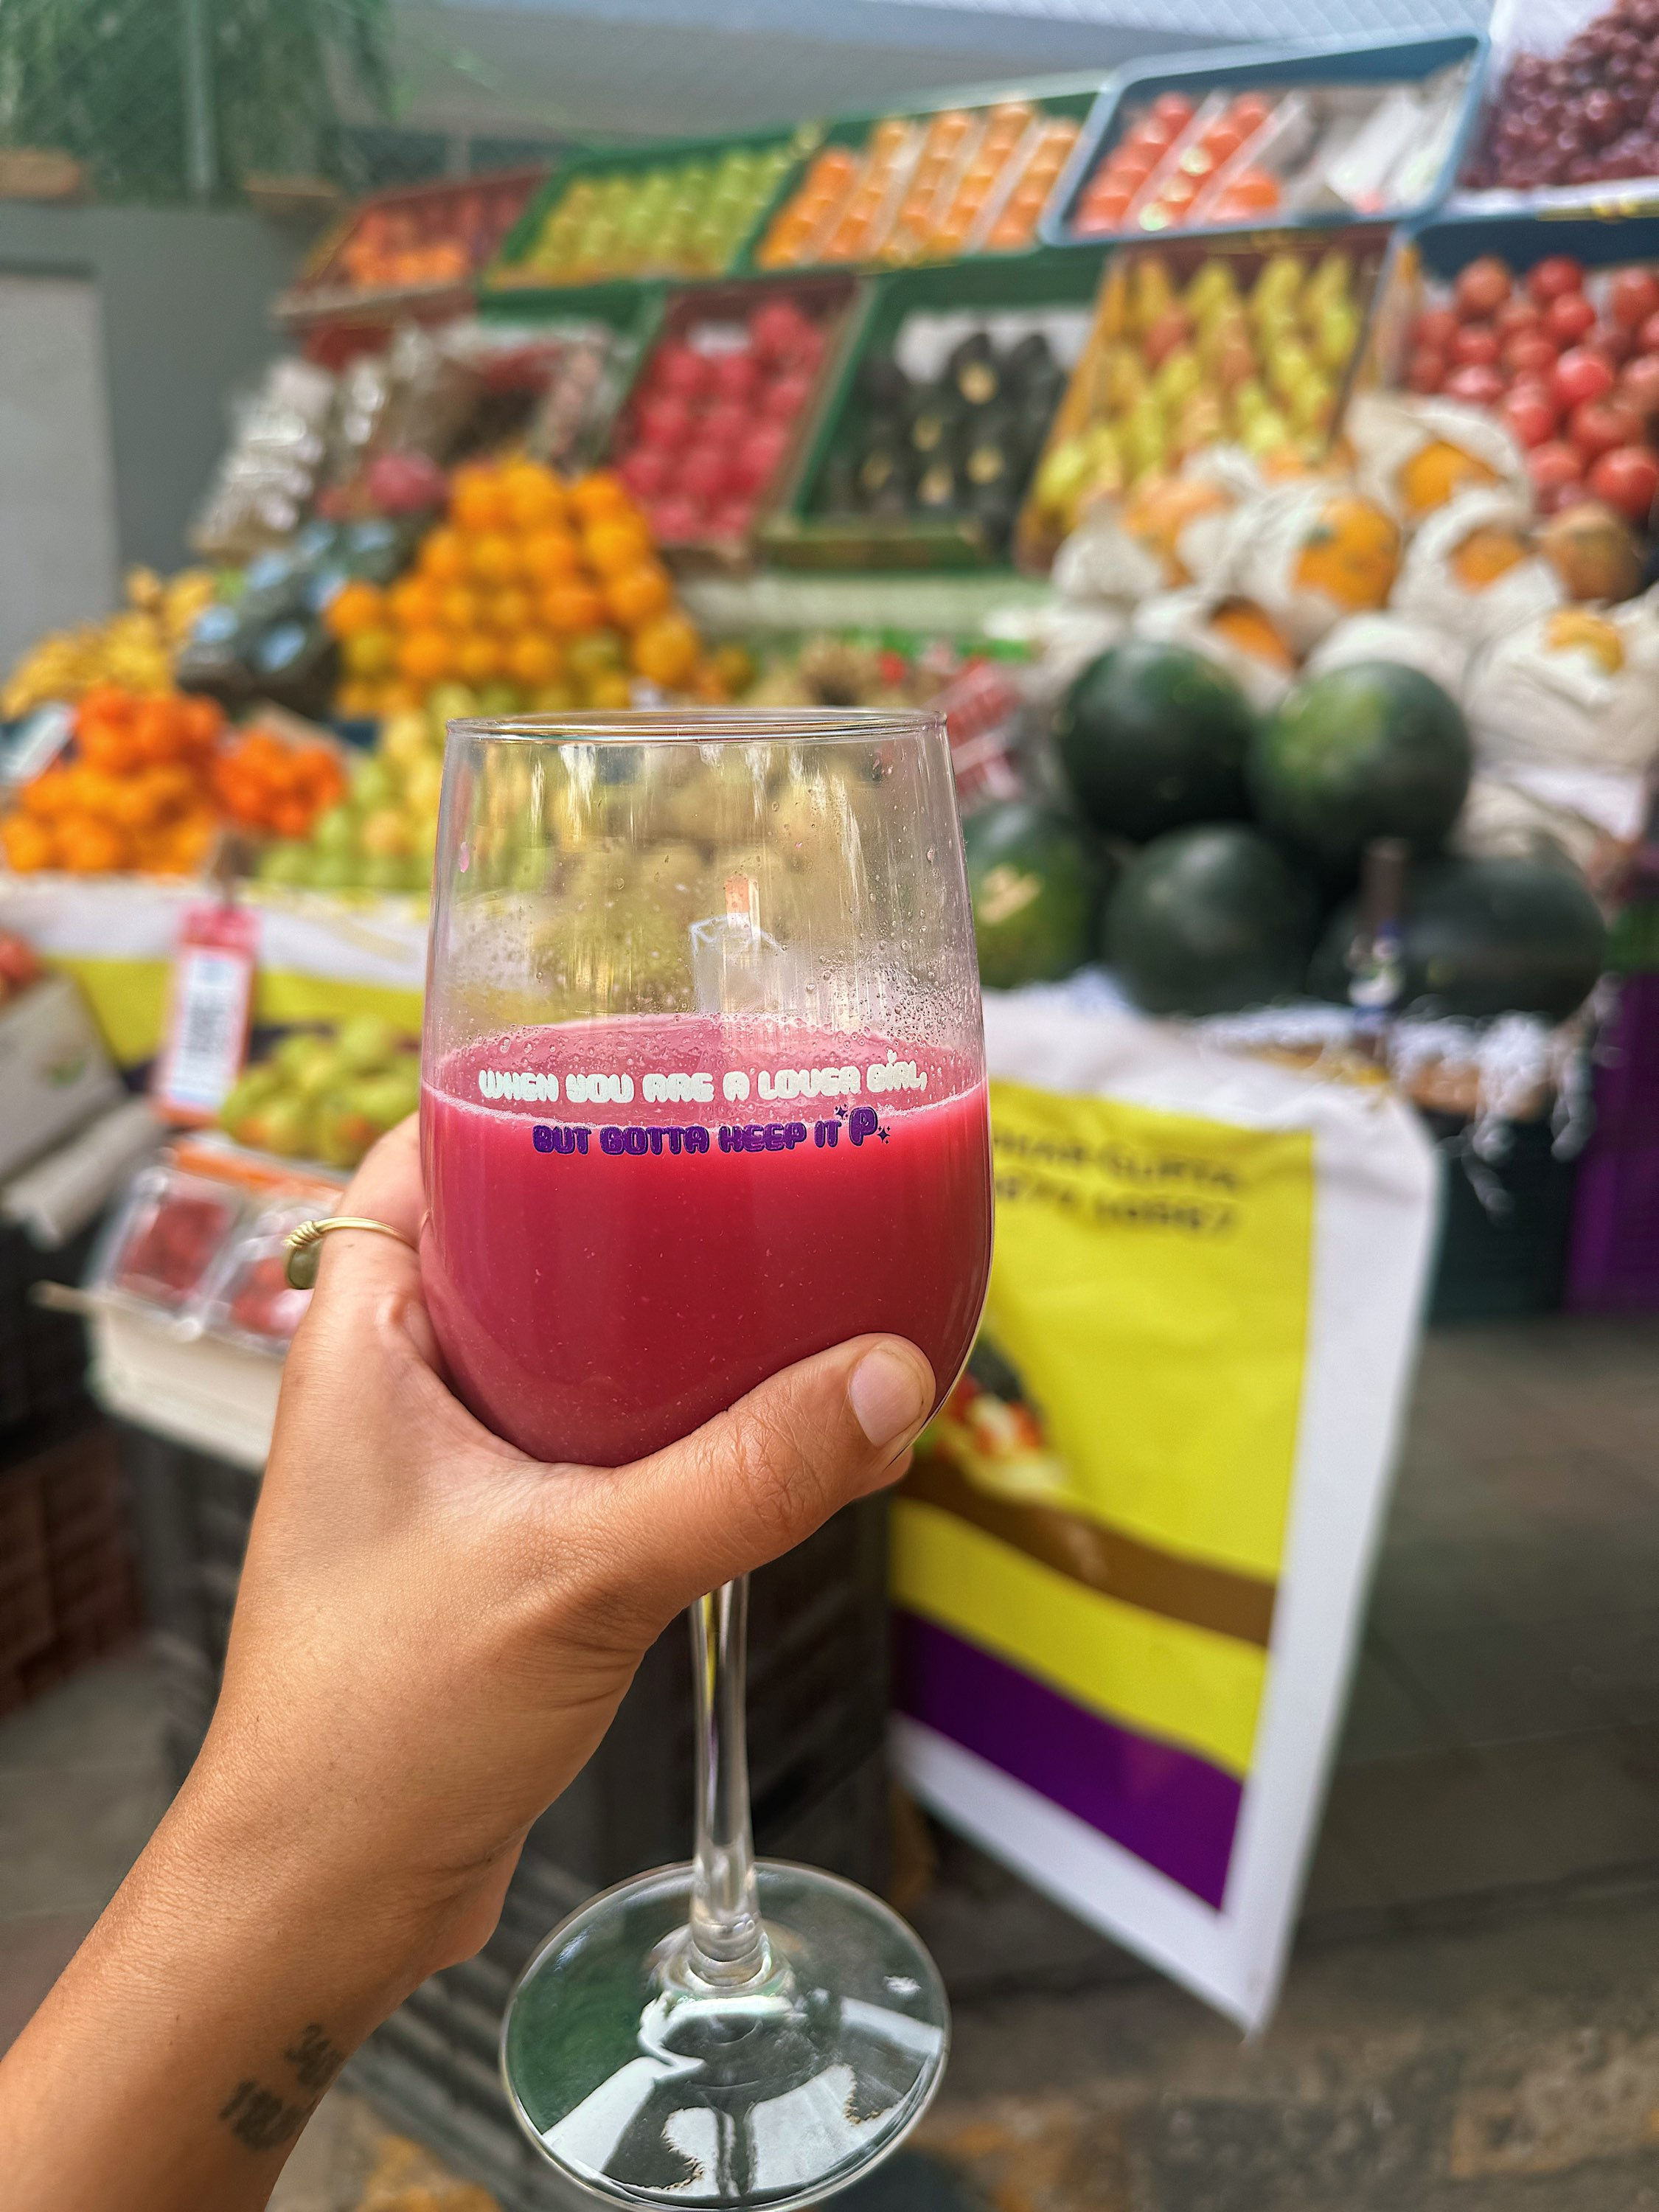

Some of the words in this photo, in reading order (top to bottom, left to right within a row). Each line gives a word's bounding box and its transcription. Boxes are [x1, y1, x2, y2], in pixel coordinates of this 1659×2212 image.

[479, 1070, 559, 1102] WHEN
[566, 1074, 634, 1103] YOU
[642, 1073, 715, 1102] ARE
[723, 1071, 751, 1102] A
[757, 1066, 862, 1100] LOVER
[532, 1125, 592, 1155] BUT
[600, 1125, 710, 1155] GOTTA
[718, 1121, 807, 1152] KEEP
[814, 1119, 842, 1147] IT
